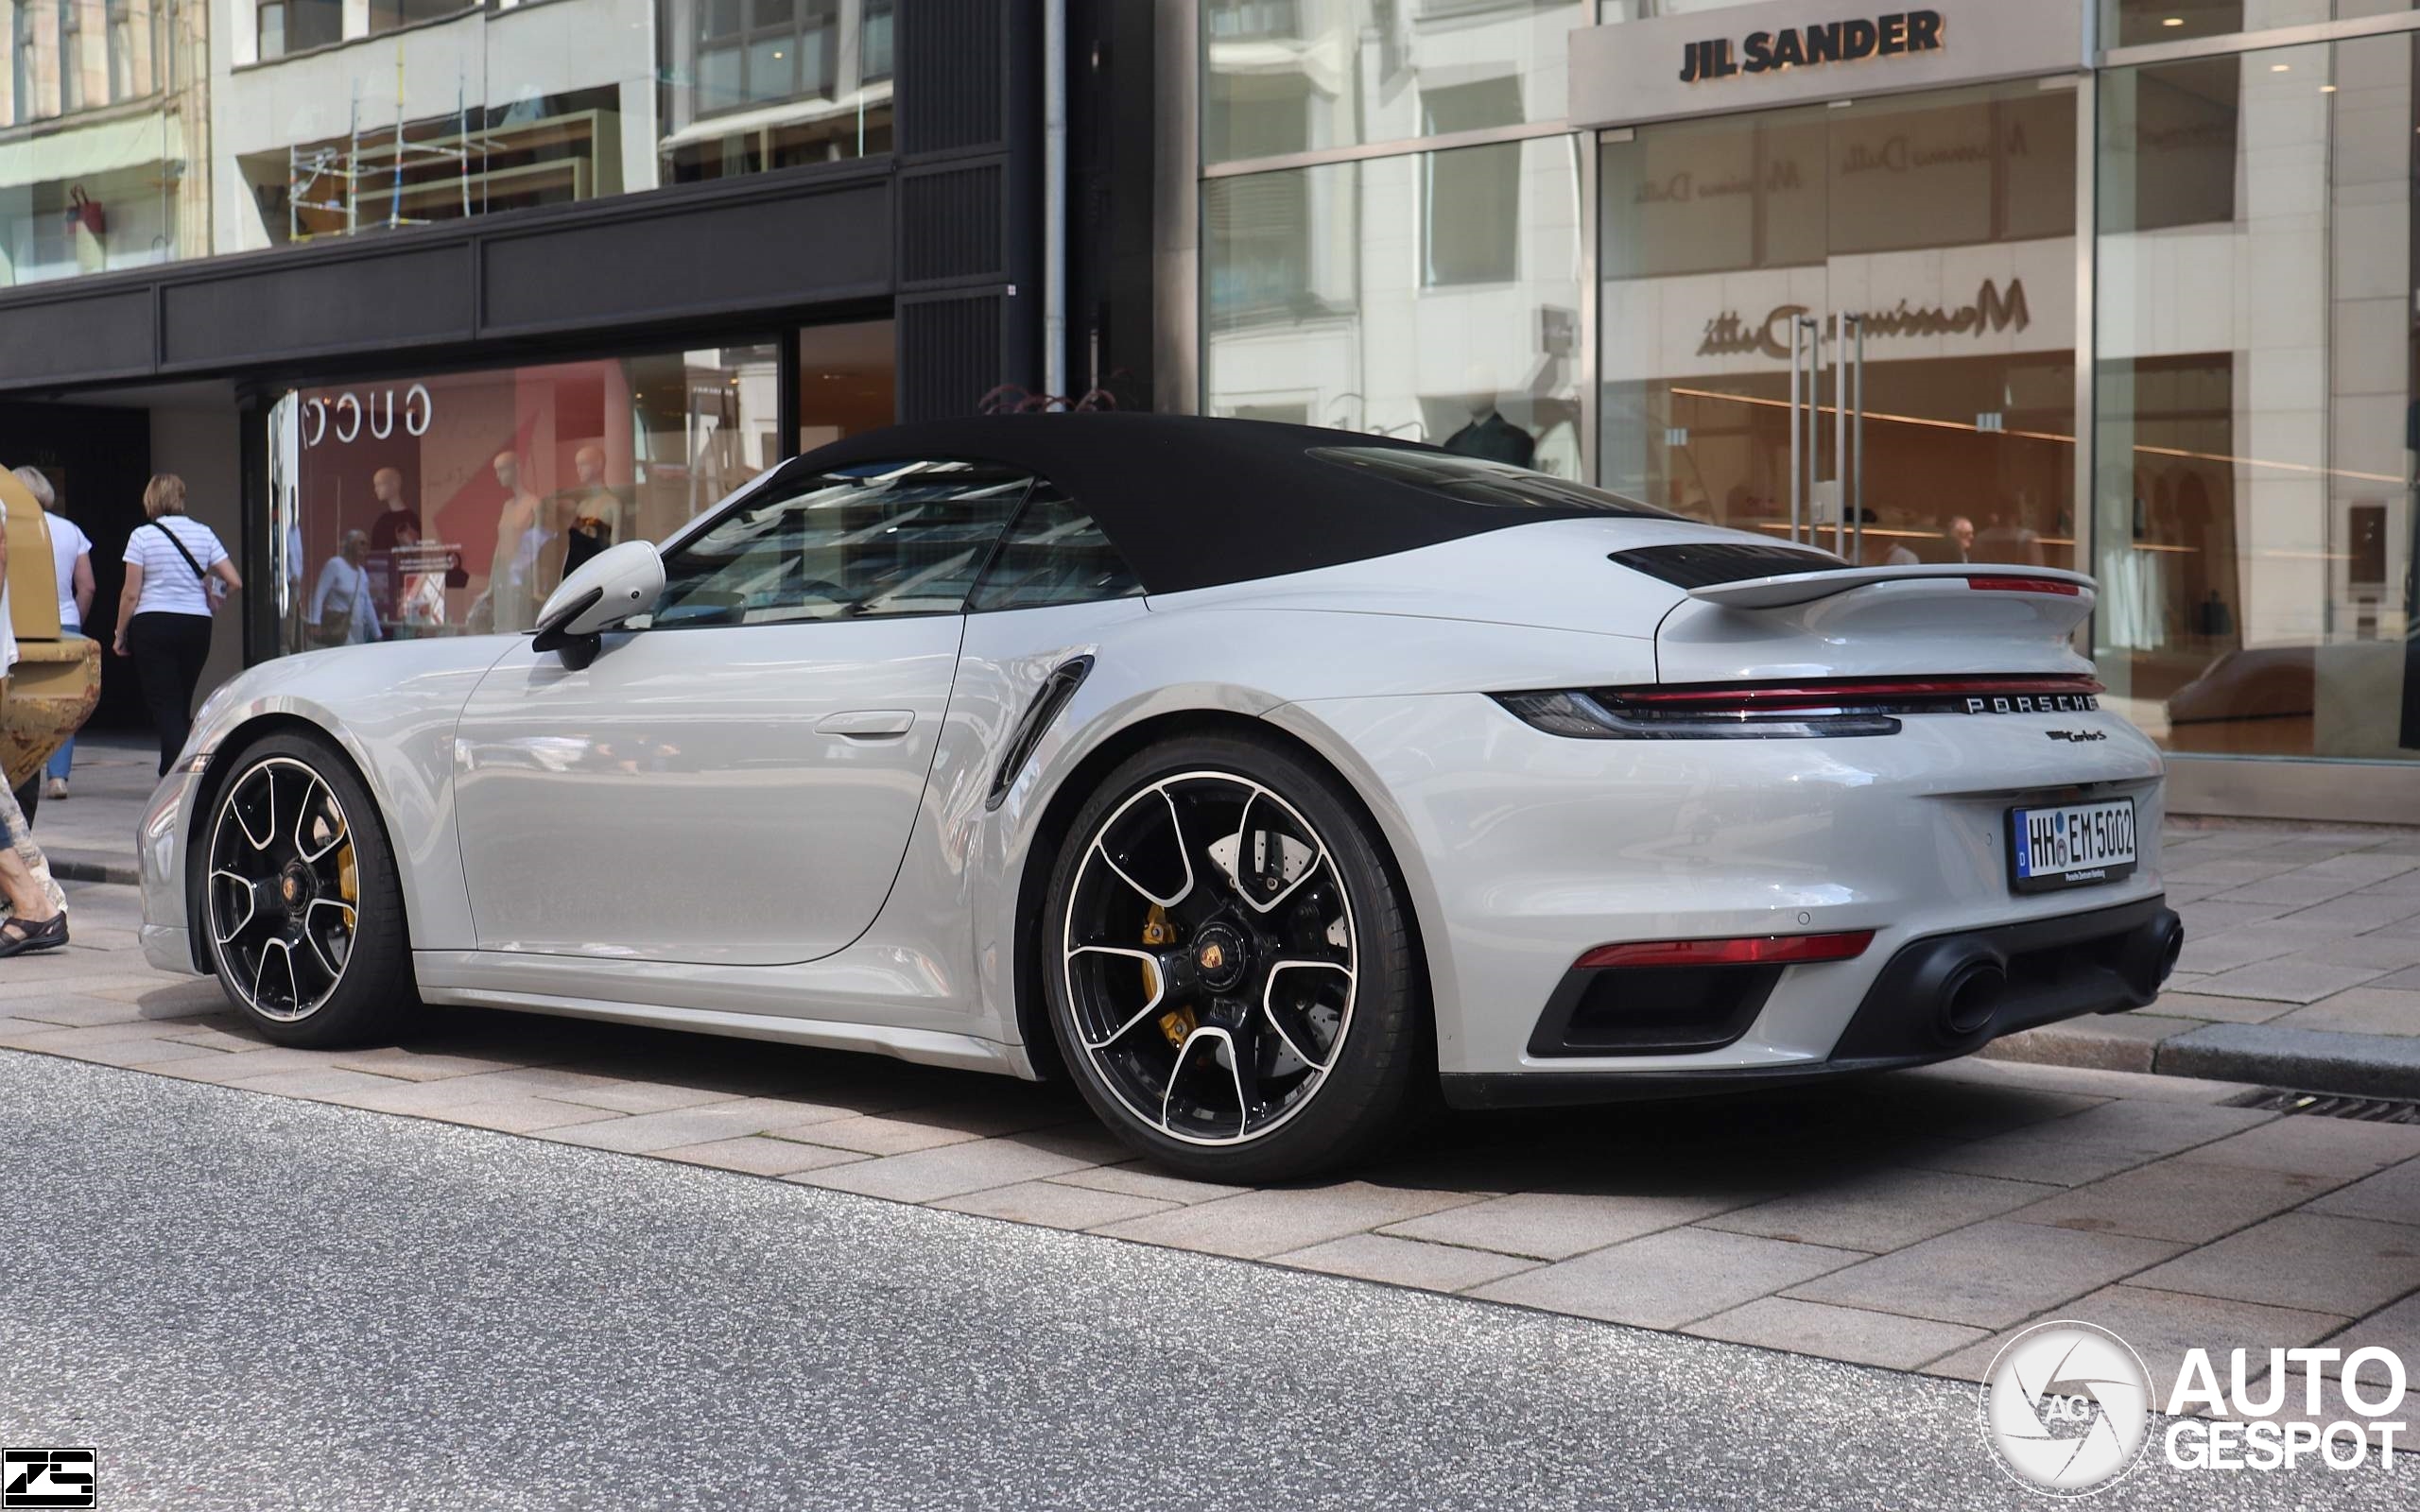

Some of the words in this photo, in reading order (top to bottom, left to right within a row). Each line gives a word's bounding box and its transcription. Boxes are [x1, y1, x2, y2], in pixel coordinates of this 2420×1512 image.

[1680, 39, 1738, 82] JIL
[1743, 9, 1943, 74] SANDER
[1965, 696, 2100, 714] PORSCHE
